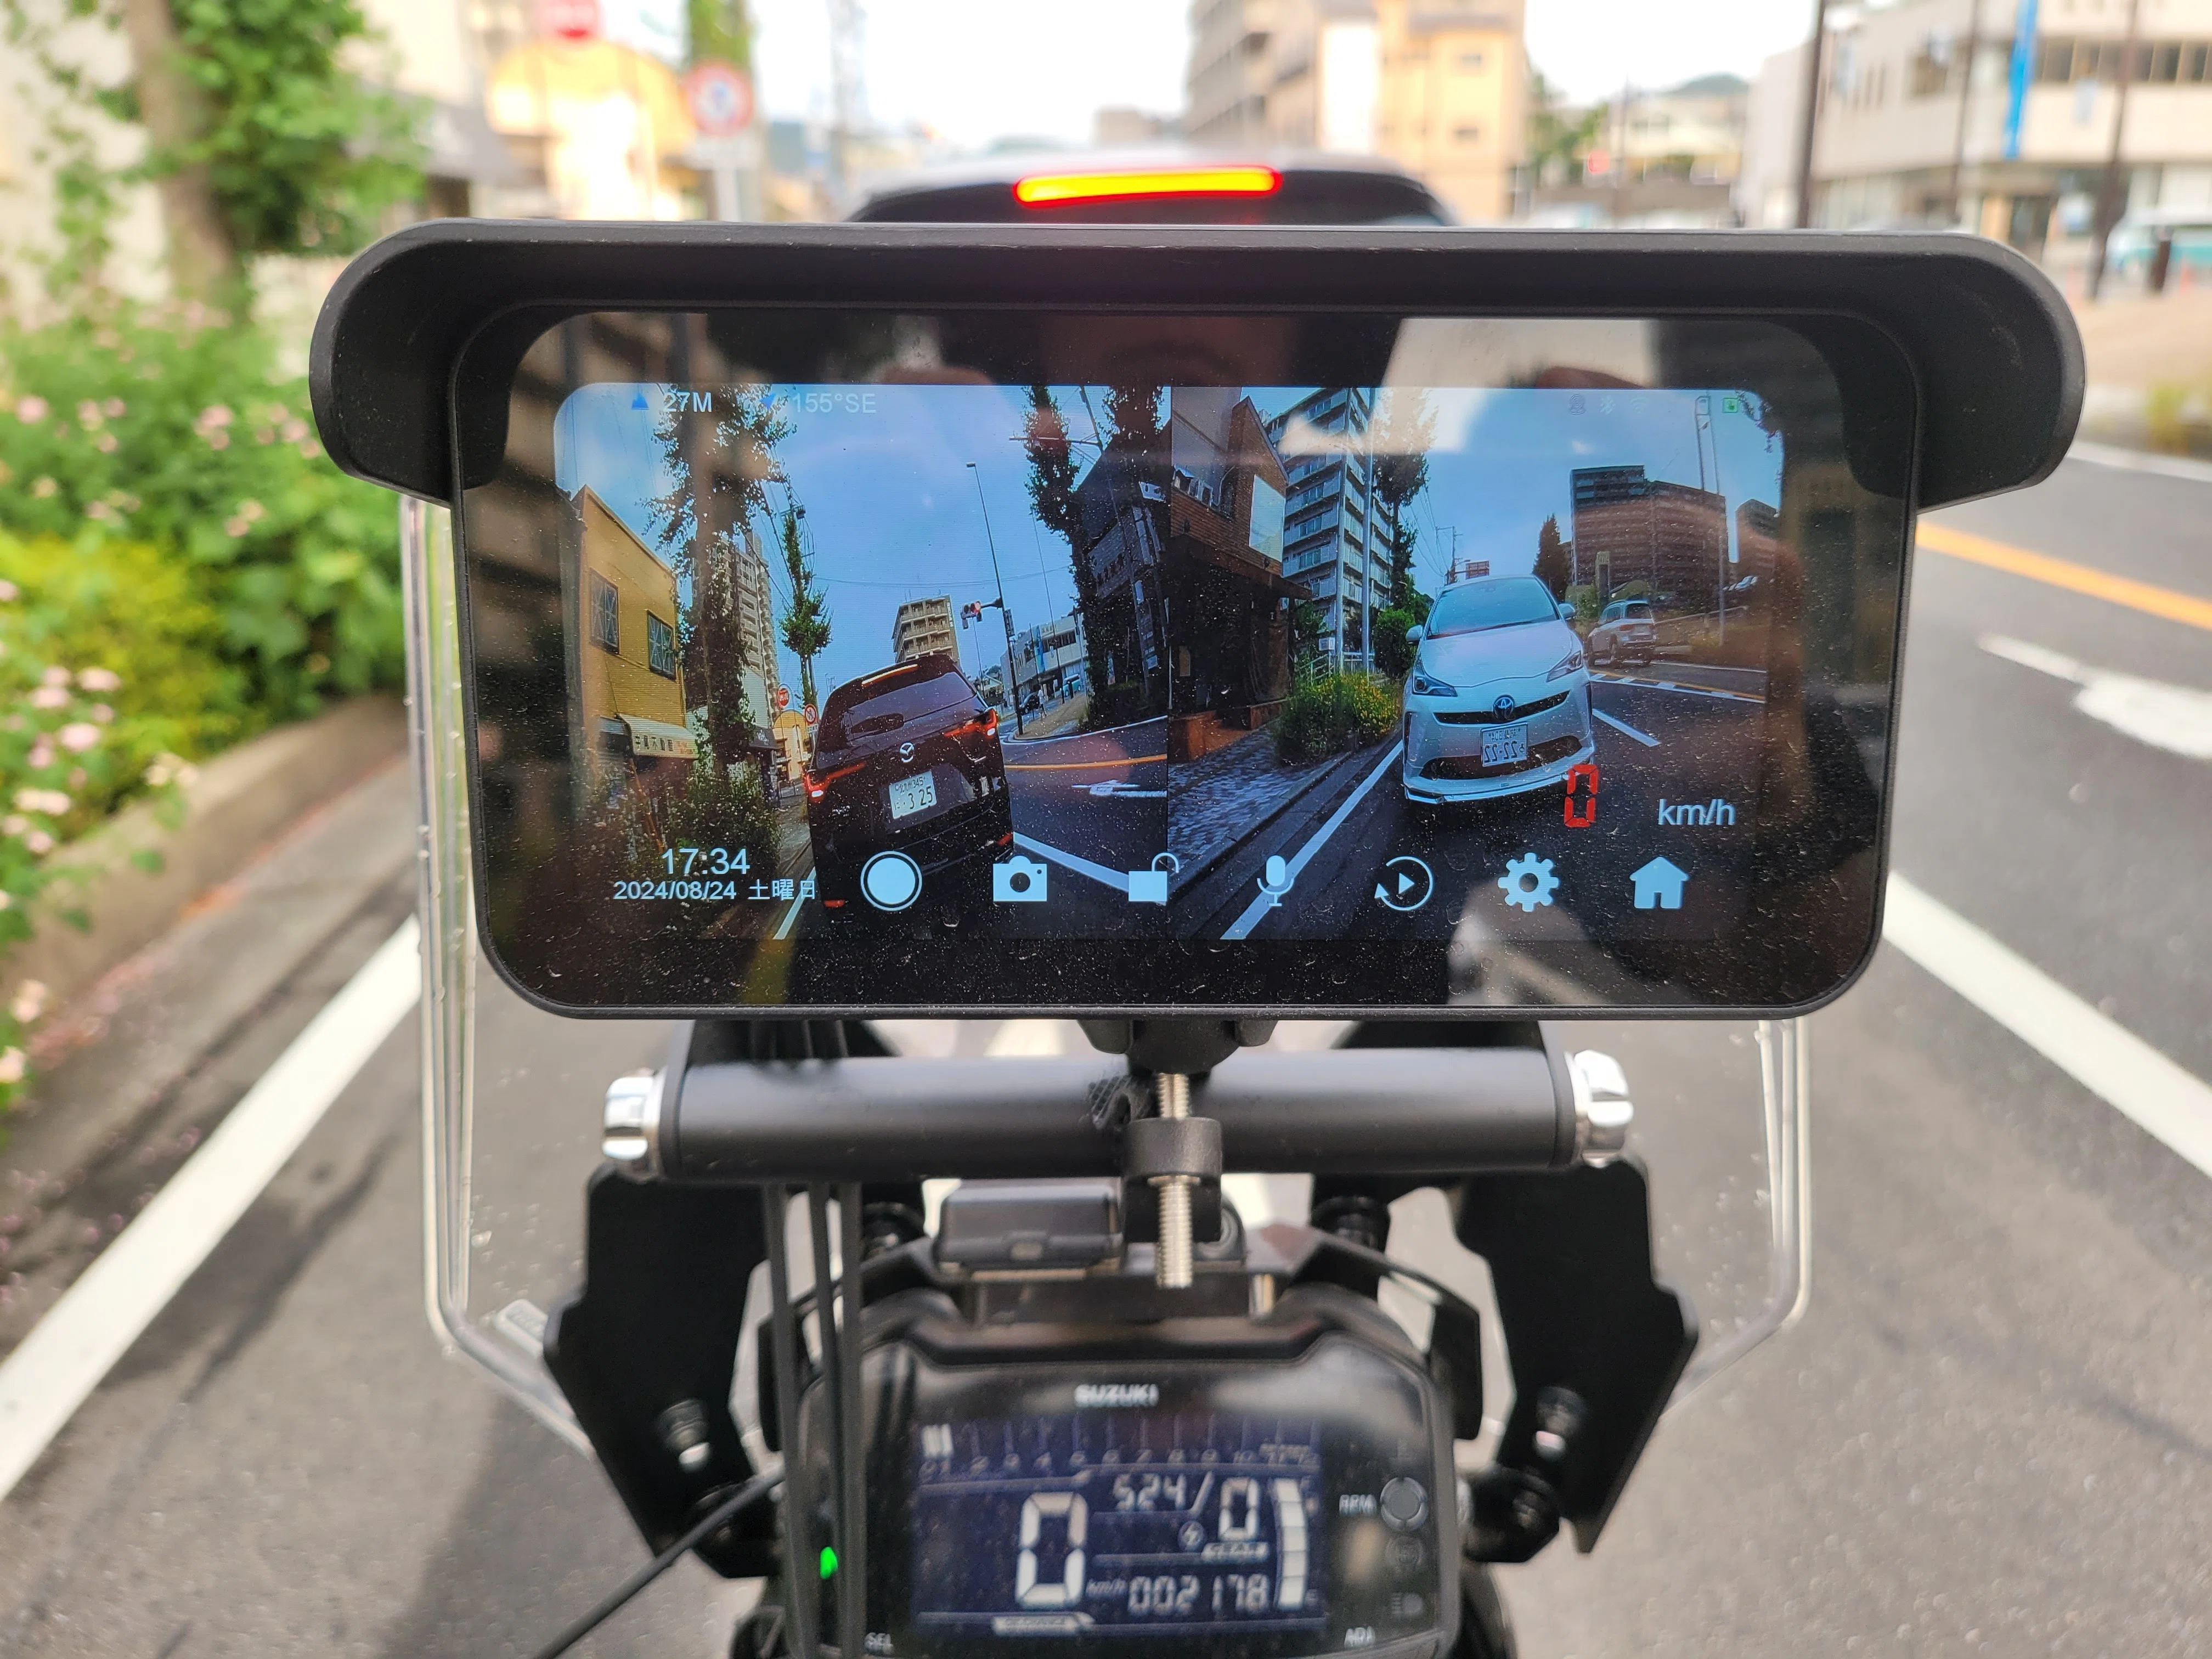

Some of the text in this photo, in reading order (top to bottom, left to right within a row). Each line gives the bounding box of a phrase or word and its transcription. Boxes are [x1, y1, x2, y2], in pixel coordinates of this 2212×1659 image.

[664, 391, 712, 413] 27M
[1564, 764, 1735, 827] 0 km/h
[661, 848, 751, 874] 17:34
[613, 879, 816, 900] 2024/08/24 土曜日
[1074, 1384, 1159, 1407] SUZUKI
[1015, 1492, 1088, 1608] 0
